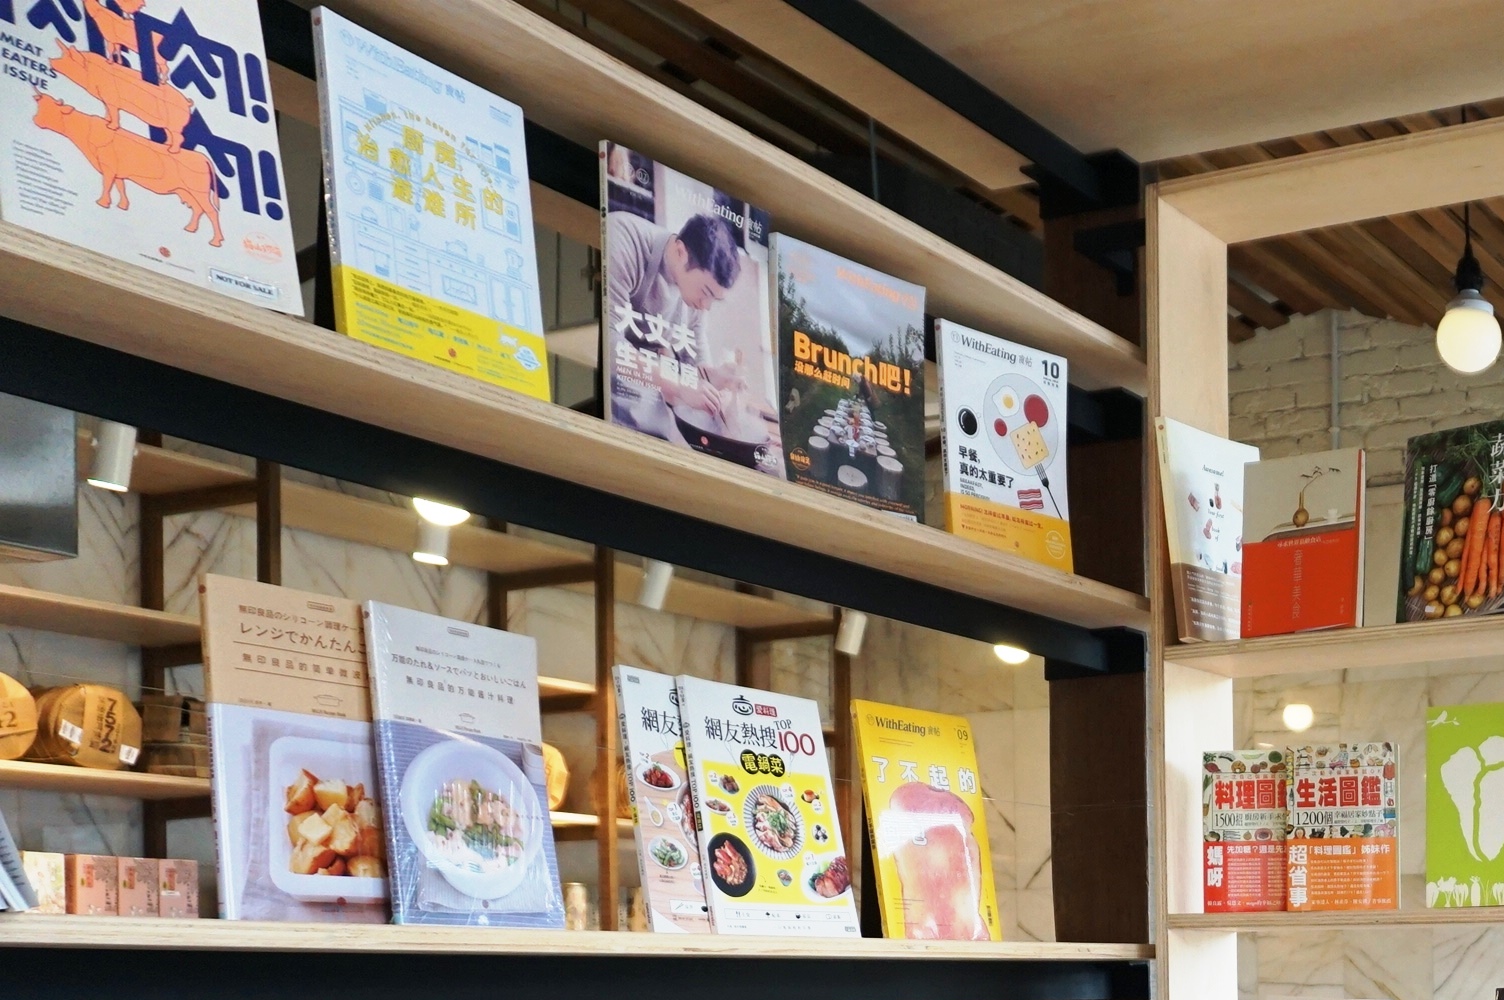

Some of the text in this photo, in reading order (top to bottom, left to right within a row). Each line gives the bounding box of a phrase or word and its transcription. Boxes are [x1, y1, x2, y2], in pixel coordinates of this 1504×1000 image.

[0, 31, 43, 58] MEAT
[1, 47, 57, 79] EATERS
[3, 64, 49, 90] ISSUE
[216, 274, 274, 296] NOT FOR SALE
[614, 302, 698, 359] 大丈夫
[961, 334, 1017, 364] WithEating
[615, 342, 699, 391] 生于厨房
[616, 365, 632, 376] MEN
[793, 330, 912, 396] Brunch吧!
[794, 360, 851, 390] 没那么赶时间
[1041, 359, 1060, 380] 10
[616, 374, 641, 388] KITCHEN
[958, 445, 981, 464] 早餐,
[959, 462, 1015, 490] 真的太重要了
[704, 715, 778, 749] 網友熱搜
[773, 718, 792, 731] TOP
[875, 716, 926, 737] WithEating
[957, 730, 969, 741] 09
[778, 731, 816, 756] 100
[741, 752, 784, 775] 電鍋菜
[871, 756, 977, 794] 了不起的
[1296, 775, 1382, 808] 生活圖鑑
[1295, 811, 1333, 826] 1200個
[1207, 845, 1223, 887] 媽呀
[1288, 844, 1308, 907] 超省事
